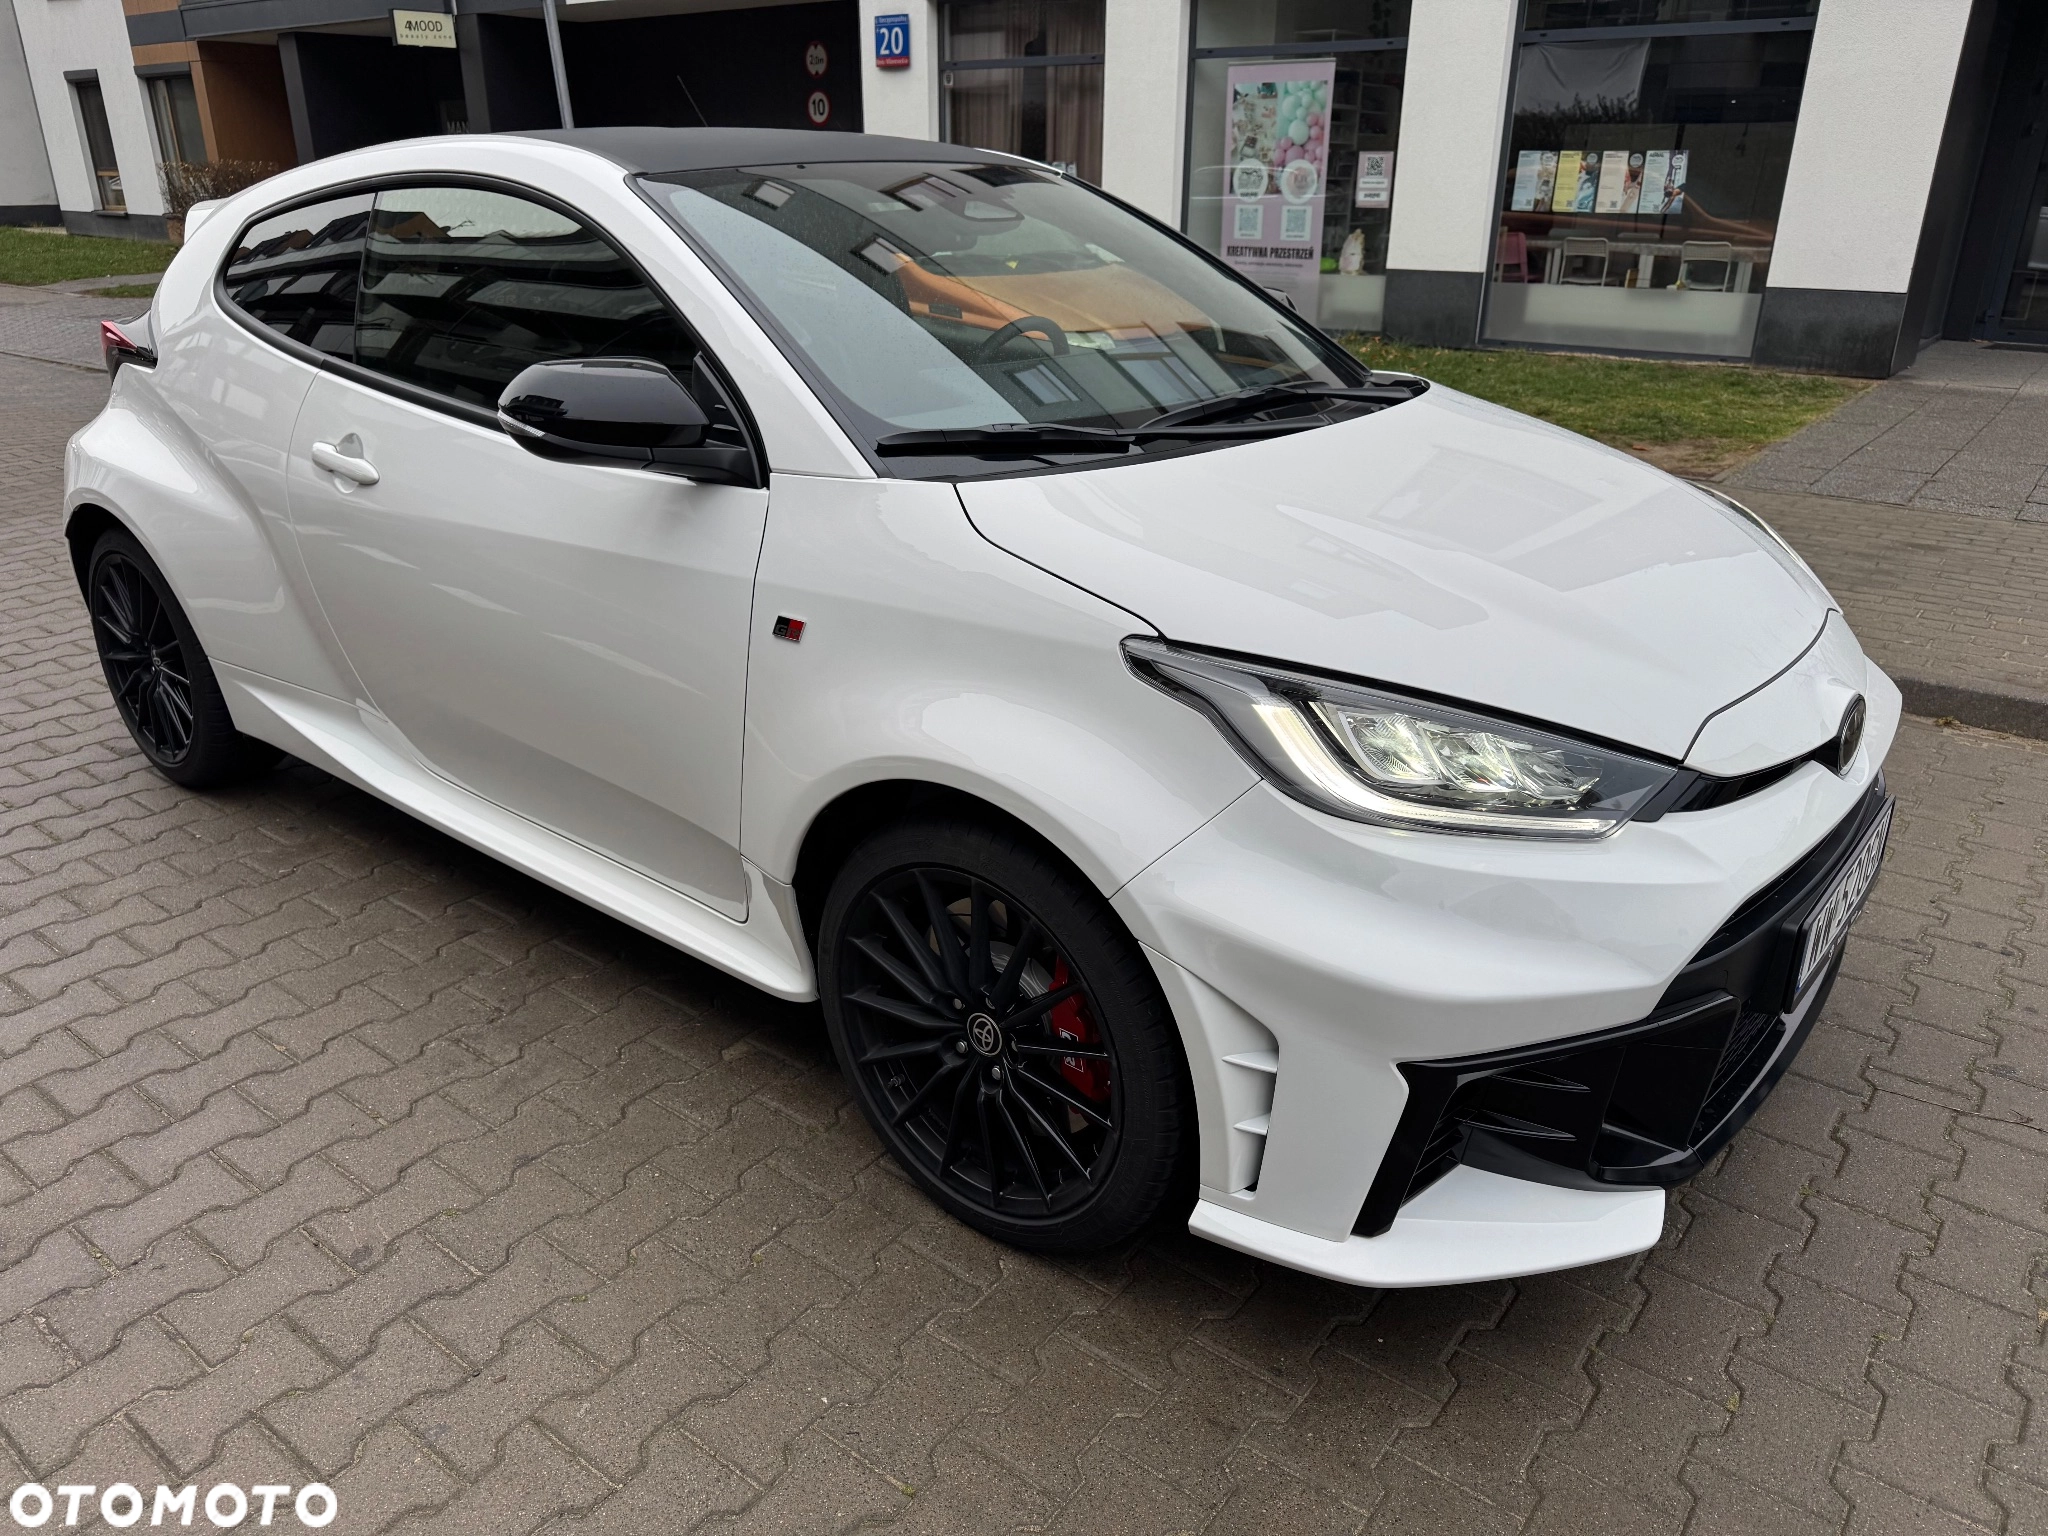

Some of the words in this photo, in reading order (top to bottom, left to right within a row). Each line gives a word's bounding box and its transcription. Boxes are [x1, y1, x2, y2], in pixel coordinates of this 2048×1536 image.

[405, 20, 443, 32] 4MOOD
[879, 26, 904, 55] 20
[812, 98, 826, 116] 10
[1227, 245, 1268, 258] KREATYWNA
[1270, 246, 1314, 260] PRZESTRZEŃ
[1807, 887, 1840, 975] WW
